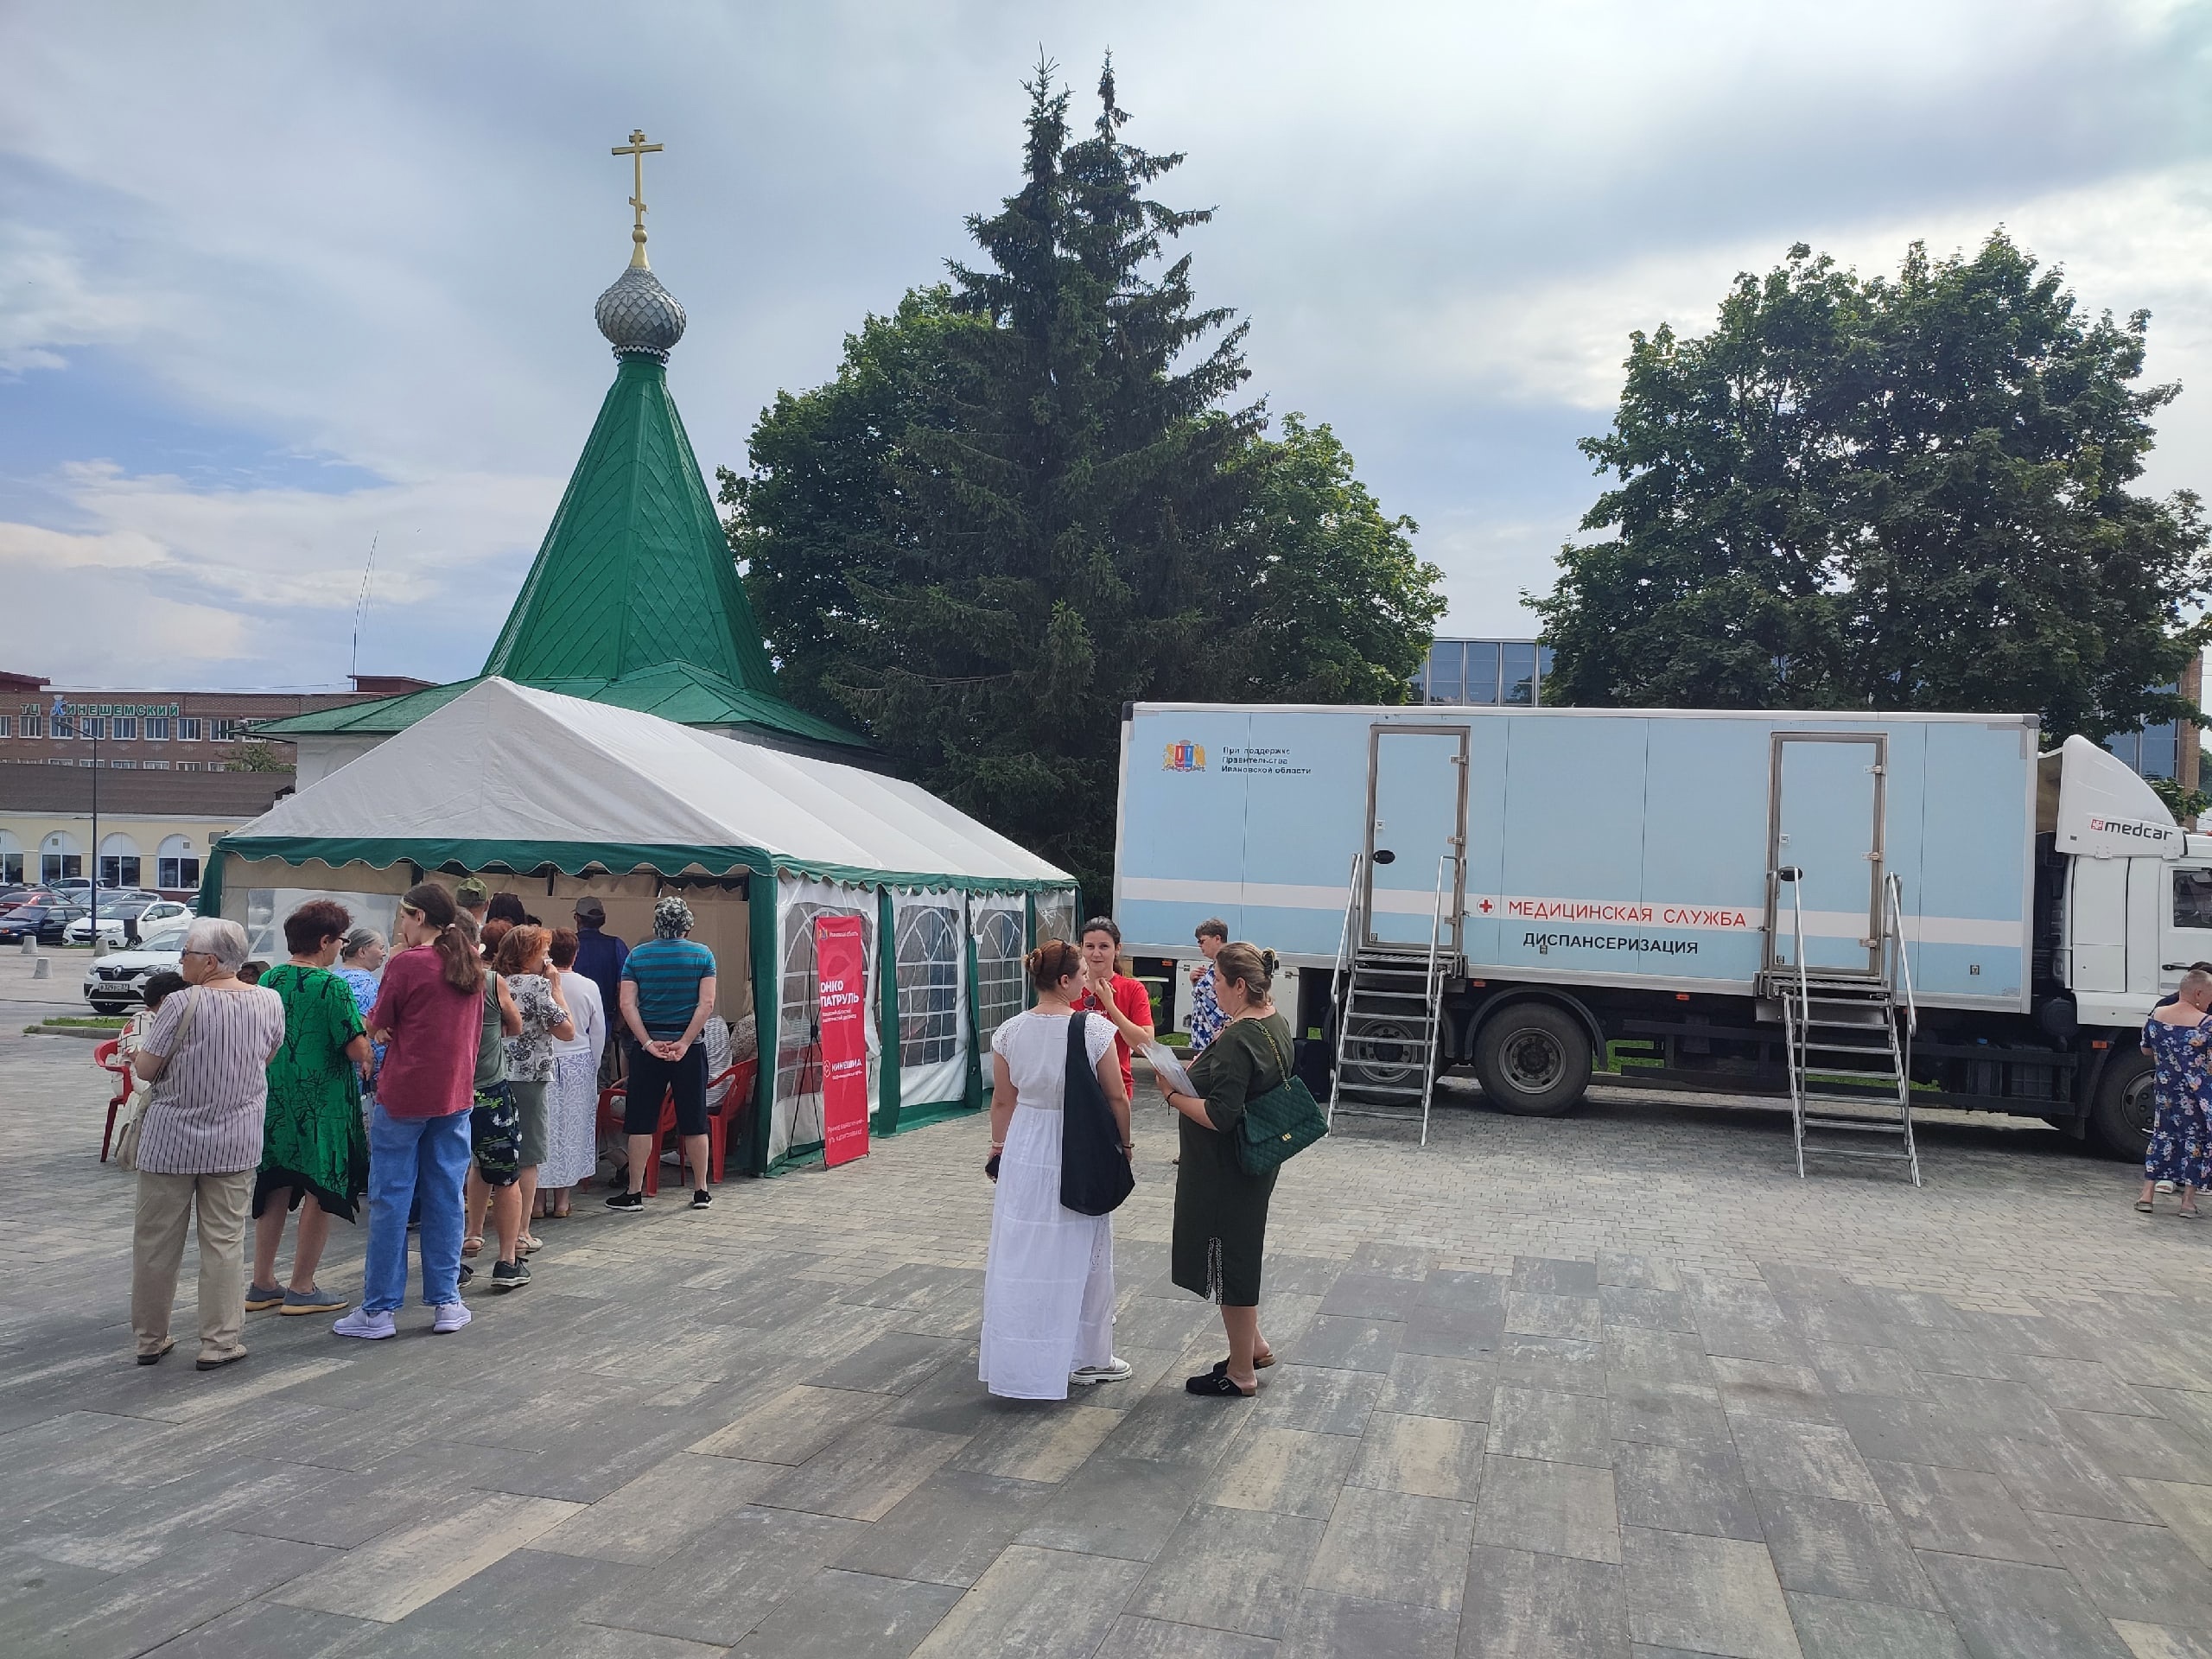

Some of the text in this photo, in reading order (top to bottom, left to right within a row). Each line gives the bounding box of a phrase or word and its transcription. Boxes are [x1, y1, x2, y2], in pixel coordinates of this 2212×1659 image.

[20, 703, 41, 716] ТЦ
[1223, 746, 1240, 755] При
[1222, 756, 1288, 765] Правительства
[1221, 765, 1313, 775] Ивановской области
[2104, 822, 2174, 841] medcar
[1508, 900, 1746, 927] МЕДИЦИНСКАЯ СЛУЖБА
[1522, 931, 1699, 955] ДИСПАНСЕРИЗАЦИЯ
[820, 980, 844, 993] ОНКО
[820, 992, 860, 1007] ПАТРУЛЬ
